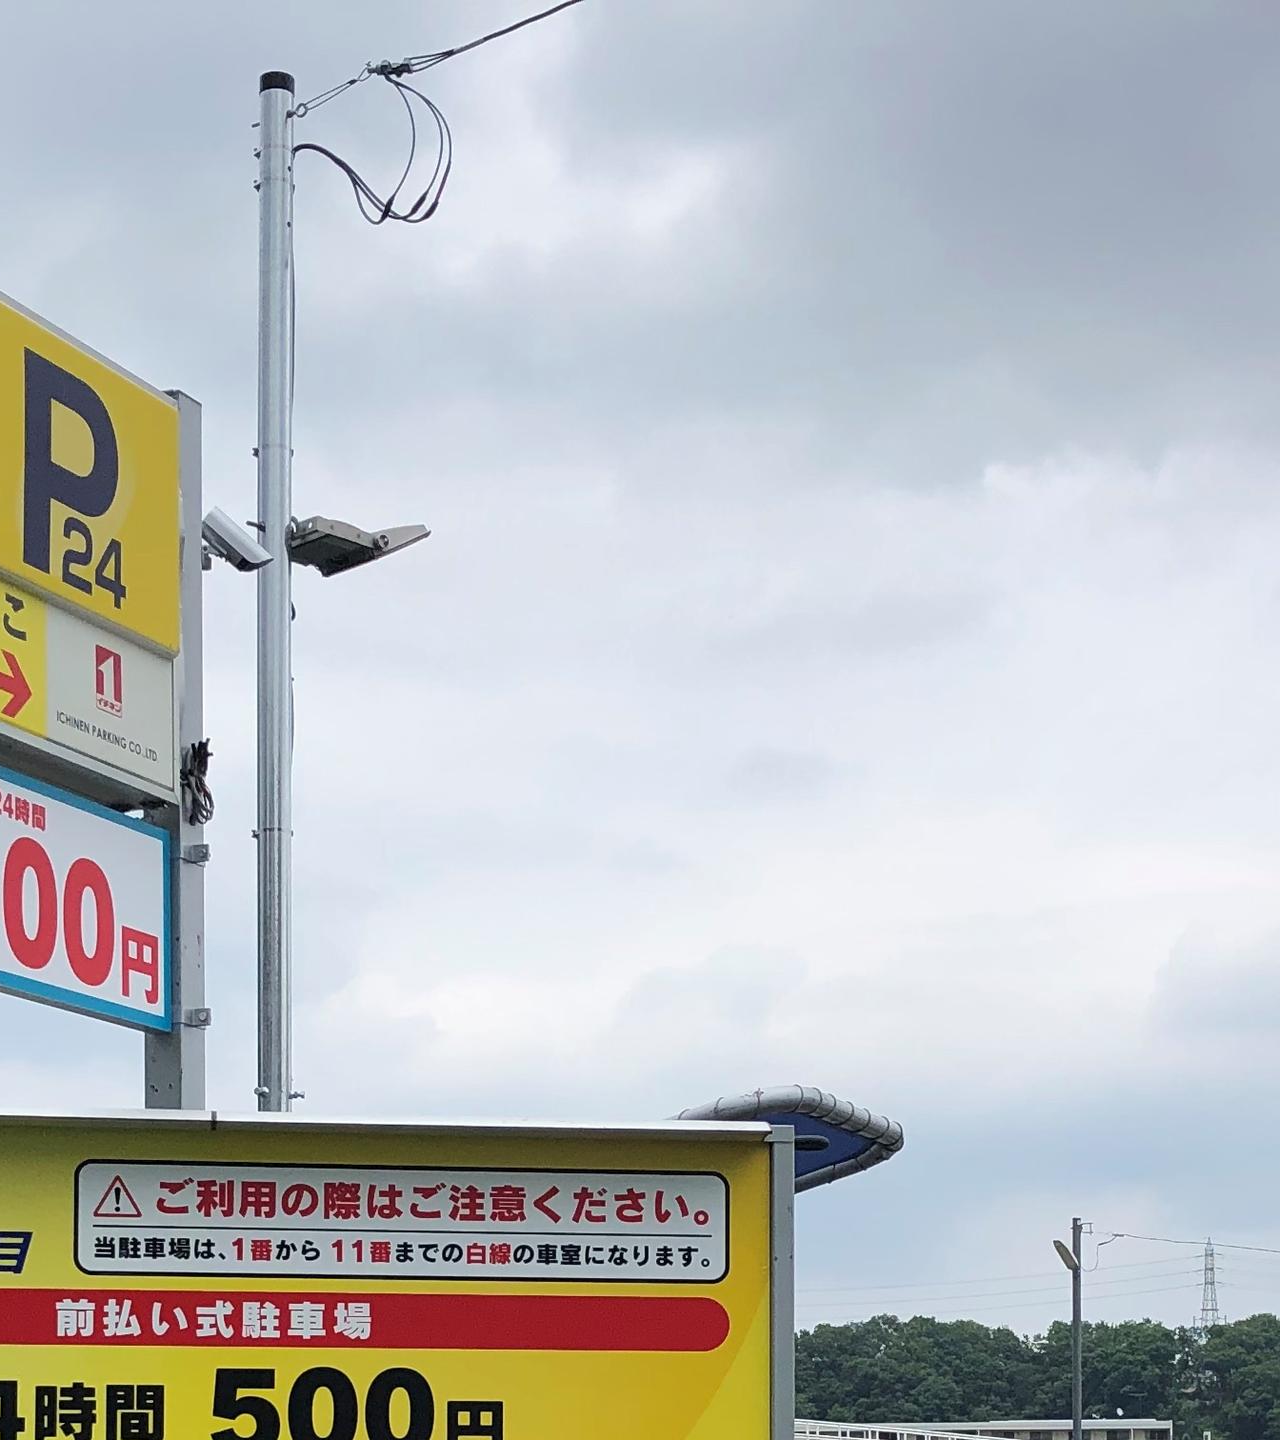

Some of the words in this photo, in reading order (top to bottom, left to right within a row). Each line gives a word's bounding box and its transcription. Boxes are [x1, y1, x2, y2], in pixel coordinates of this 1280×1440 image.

[23, 346, 119, 574] P
[62, 517, 127, 609] 24
[56, 710, 90, 736] ICHINEN
[92, 725, 127, 750] PARKING
[156, 1177, 710, 1226] ご利用の際はご注意ください。
[55, 1298, 373, 1340] 前払い式駐車場
